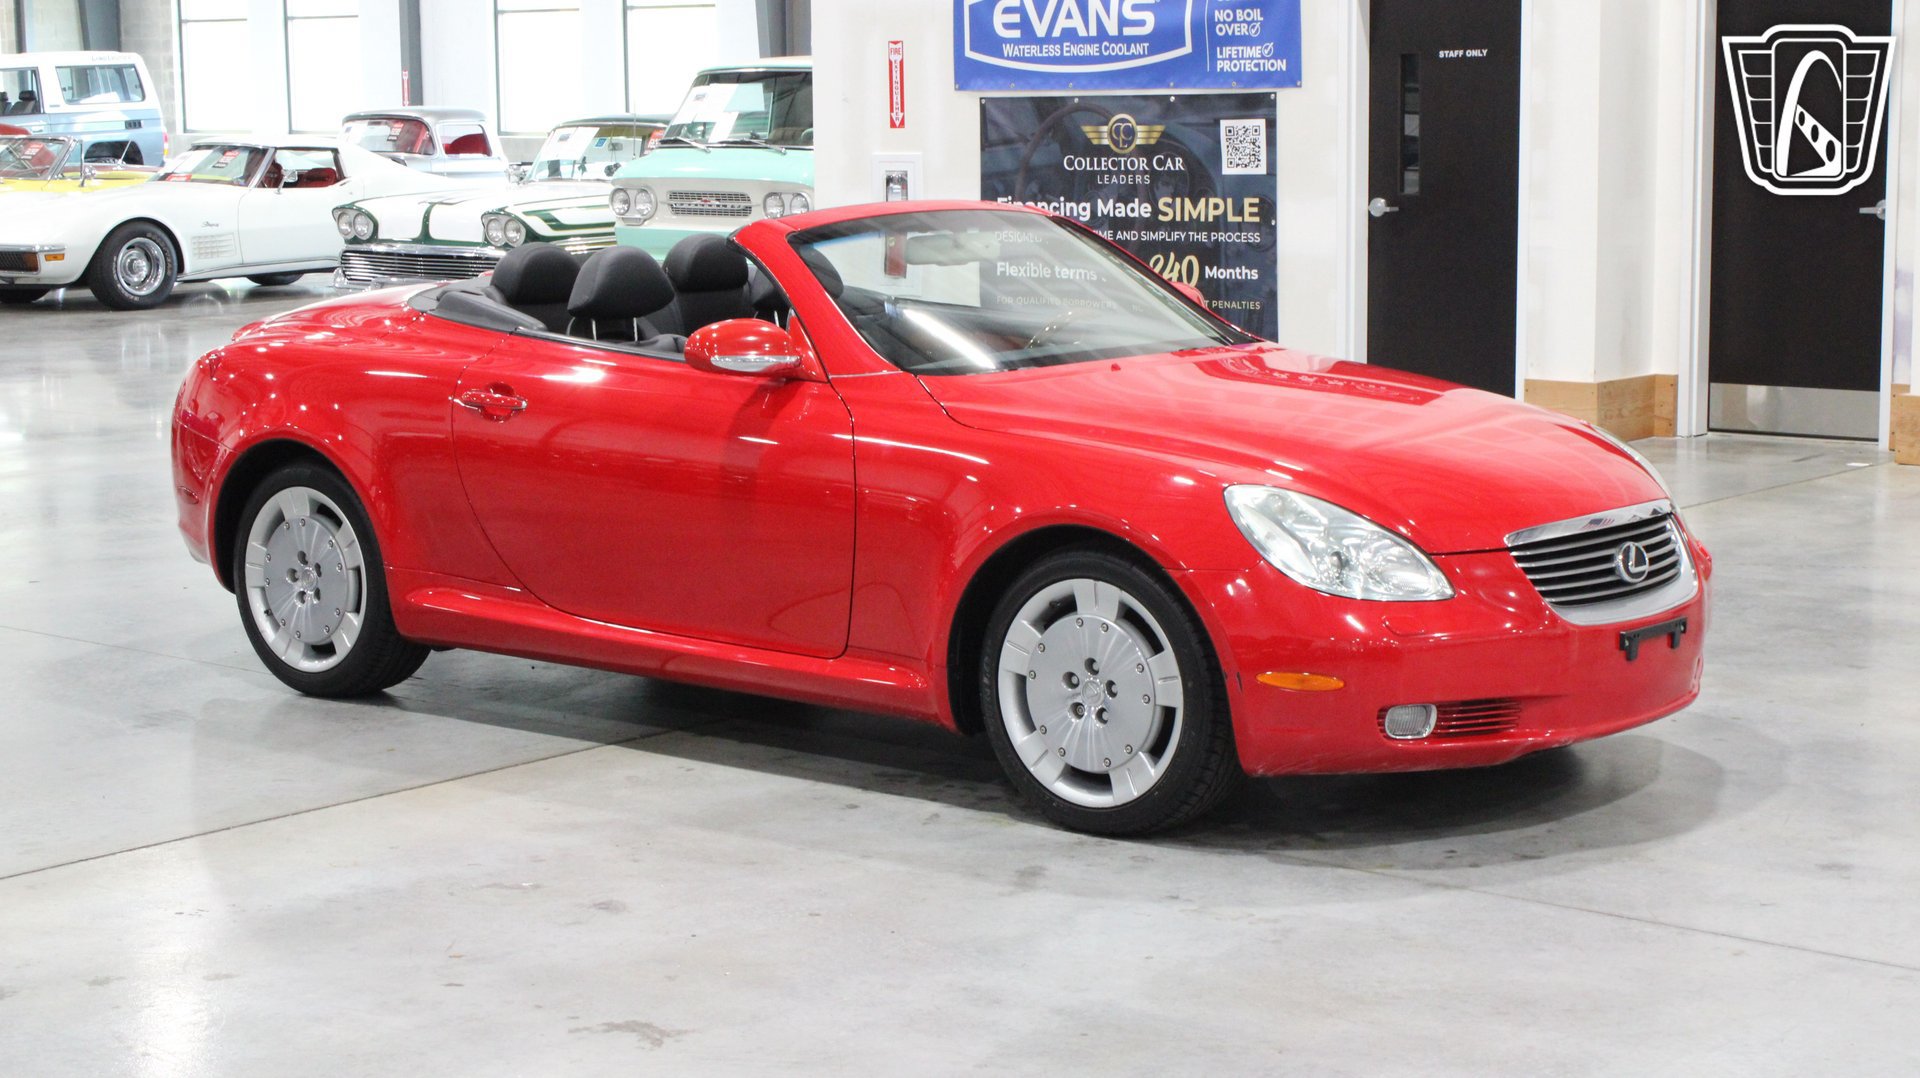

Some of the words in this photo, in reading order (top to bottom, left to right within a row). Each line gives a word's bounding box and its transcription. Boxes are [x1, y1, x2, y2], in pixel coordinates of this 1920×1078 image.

[993, 0, 1155, 38] EVANS
[1214, 9, 1233, 22] NO
[1236, 8, 1264, 21] BOIL
[1216, 23, 1249, 36] OVER
[1002, 43, 1061, 57] WATERLESS
[1063, 42, 1099, 56] ENGINE
[1101, 41, 1149, 56] COOLANT
[1216, 46, 1262, 59] LIFETIME
[1438, 50, 1464, 58] STAFF
[1465, 49, 1488, 57] ONLY
[1217, 59, 1287, 72] PROTECTION
[1063, 155, 1150, 171] COLLECTOR
[1152, 155, 1185, 171] CAR
[1097, 175, 1151, 184] LEADERS
[997, 195, 1091, 221] incing
[1097, 198, 1152, 217] Made
[1157, 197, 1260, 222] SIMPLE
[1115, 230, 1139, 241] AND
[1140, 231, 1186, 242] SIMPLIFY
[1188, 232, 1208, 242] THE
[1210, 232, 1261, 243] PROCESS
[996, 261, 1051, 278] Flexible
[1054, 264, 1098, 280] terms
[1149, 251, 1200, 287] 240
[1204, 265, 1258, 280] Months
[996, 296, 1014, 305] FOR
[1212, 300, 1261, 310] PENALTIES
